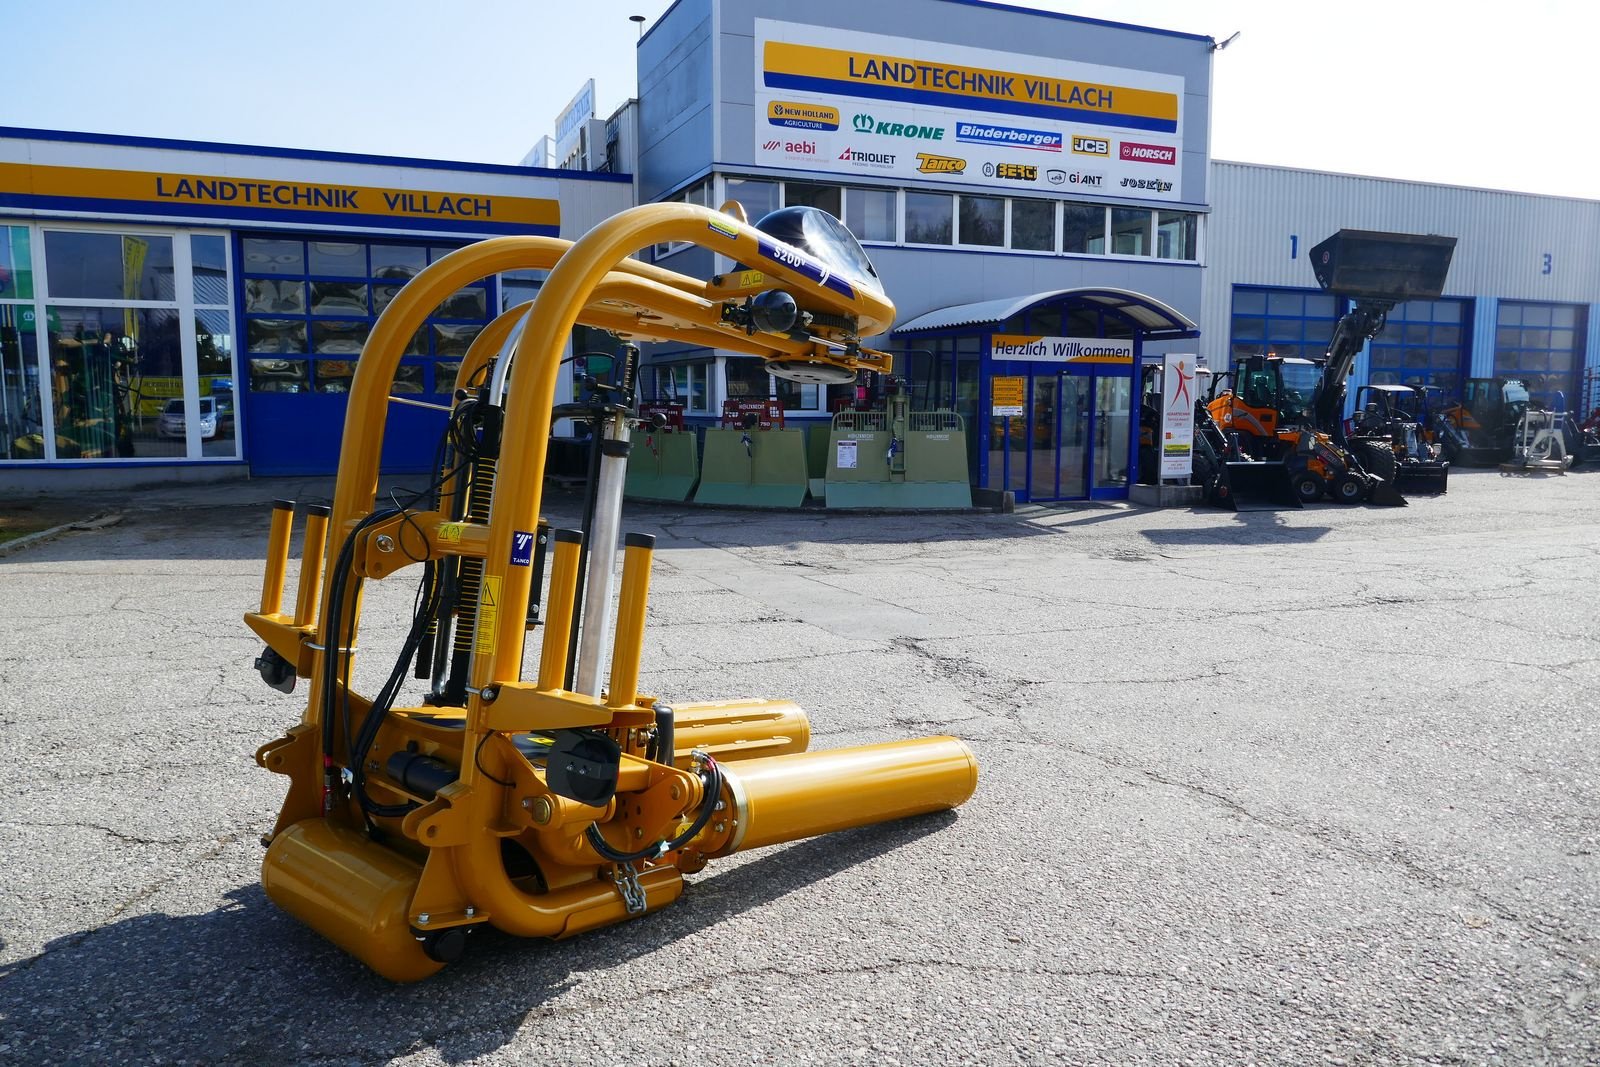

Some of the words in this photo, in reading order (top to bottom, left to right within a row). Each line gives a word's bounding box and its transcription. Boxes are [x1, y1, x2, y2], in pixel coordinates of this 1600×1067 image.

[849, 57, 1014, 96] LANDTECHNIK
[1024, 79, 1113, 108] VILLACH
[784, 108, 800, 116] NEW
[802, 110, 834, 119] HOLLAND
[784, 119, 823, 129] AGRICULTURE
[875, 121, 945, 140] KRONE
[959, 125, 1060, 144] Binderberger
[785, 141, 815, 154] aebi
[1074, 138, 1107, 153] JCB
[1131, 147, 1173, 160] HORSCH
[850, 151, 896, 164] TRIOLIET
[916, 152, 966, 174] Tanco
[156, 177, 359, 209] LANDTECHNIK
[383, 192, 491, 217] VILLACH
[1290, 235, 1297, 259] 1
[1542, 253, 1552, 275] 3
[995, 341, 1047, 356] Herzlich
[1052, 343, 1130, 358] Willkommen
